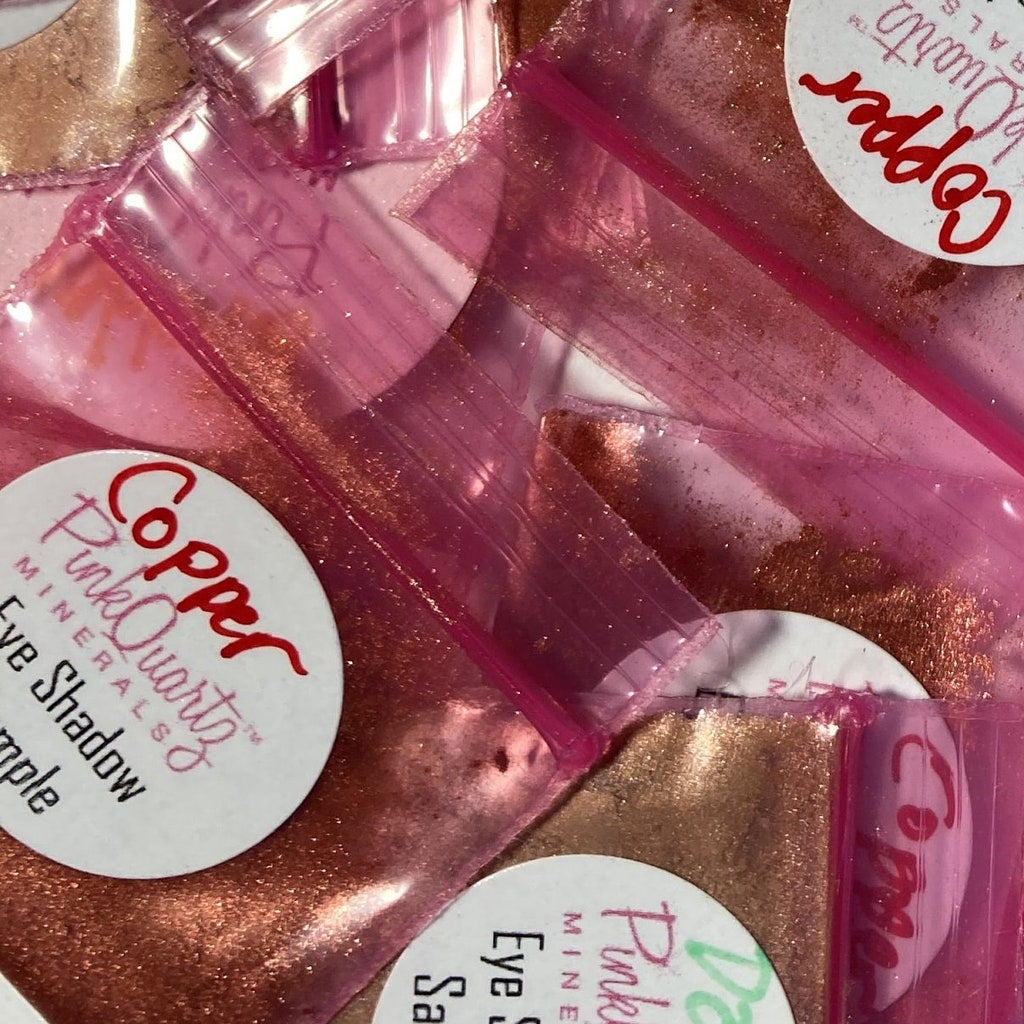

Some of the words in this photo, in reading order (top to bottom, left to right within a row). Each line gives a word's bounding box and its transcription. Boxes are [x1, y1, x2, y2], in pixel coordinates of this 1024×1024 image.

[798, 71, 1011, 254] Copper
[14, 556, 171, 742] MINERALS
[107, 461, 309, 676] Copper
[0, 728, 61, 814] mple
[30, 659, 147, 802] Shadow
[480, 930, 545, 998] Eye
